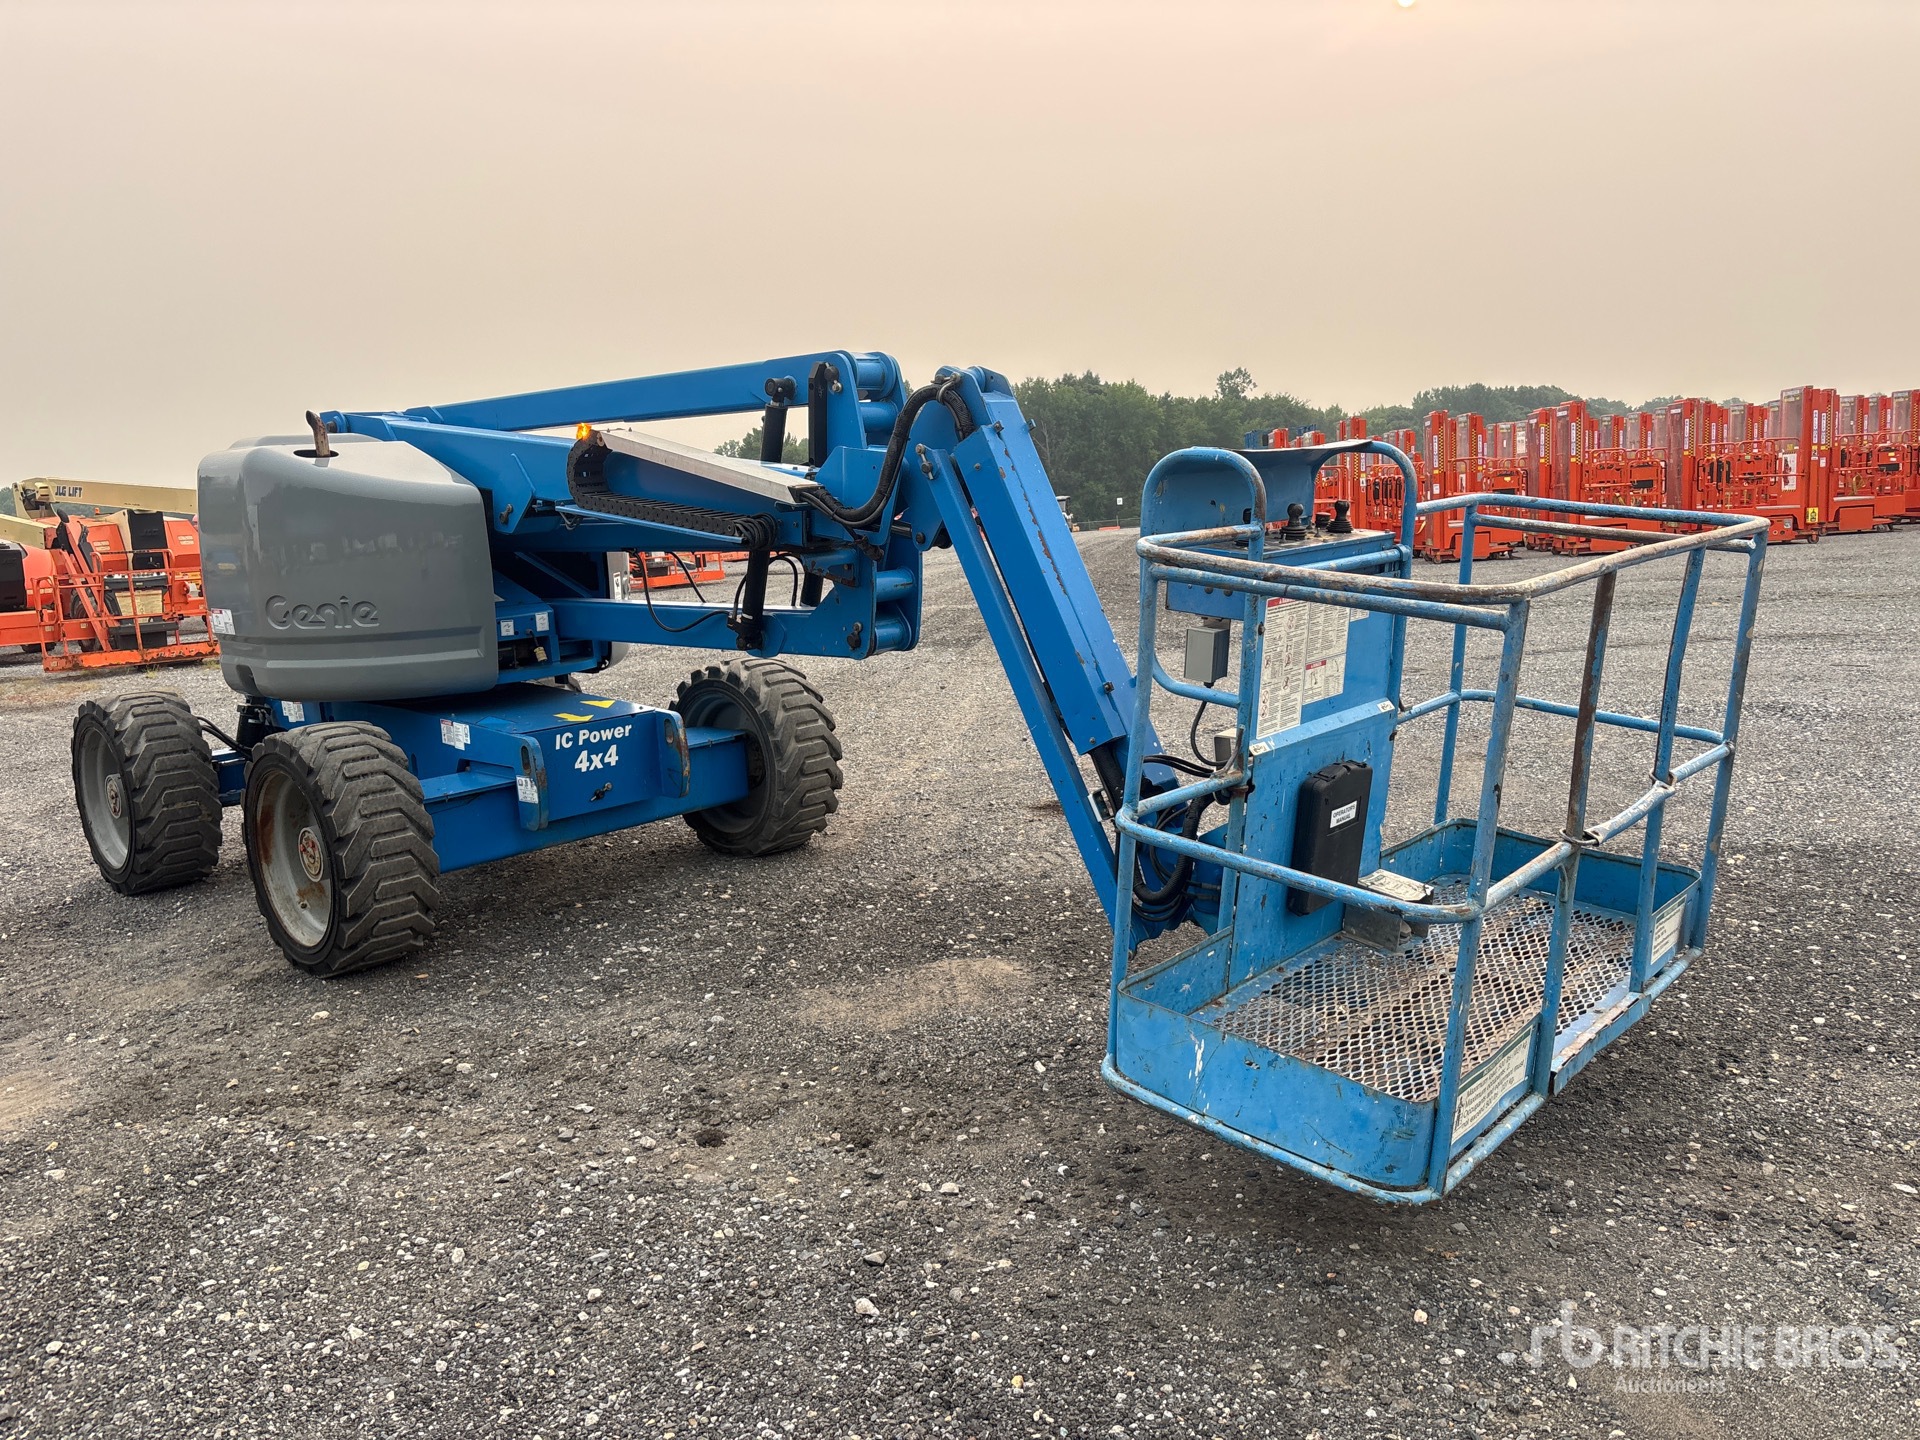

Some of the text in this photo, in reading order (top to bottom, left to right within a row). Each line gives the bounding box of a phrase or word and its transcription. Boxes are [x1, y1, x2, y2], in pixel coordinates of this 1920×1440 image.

[55, 486, 82, 498] JLG LIFT
[265, 595, 380, 630] Genie
[555, 724, 632, 750] IC Power
[574, 744, 619, 773] 4x4
